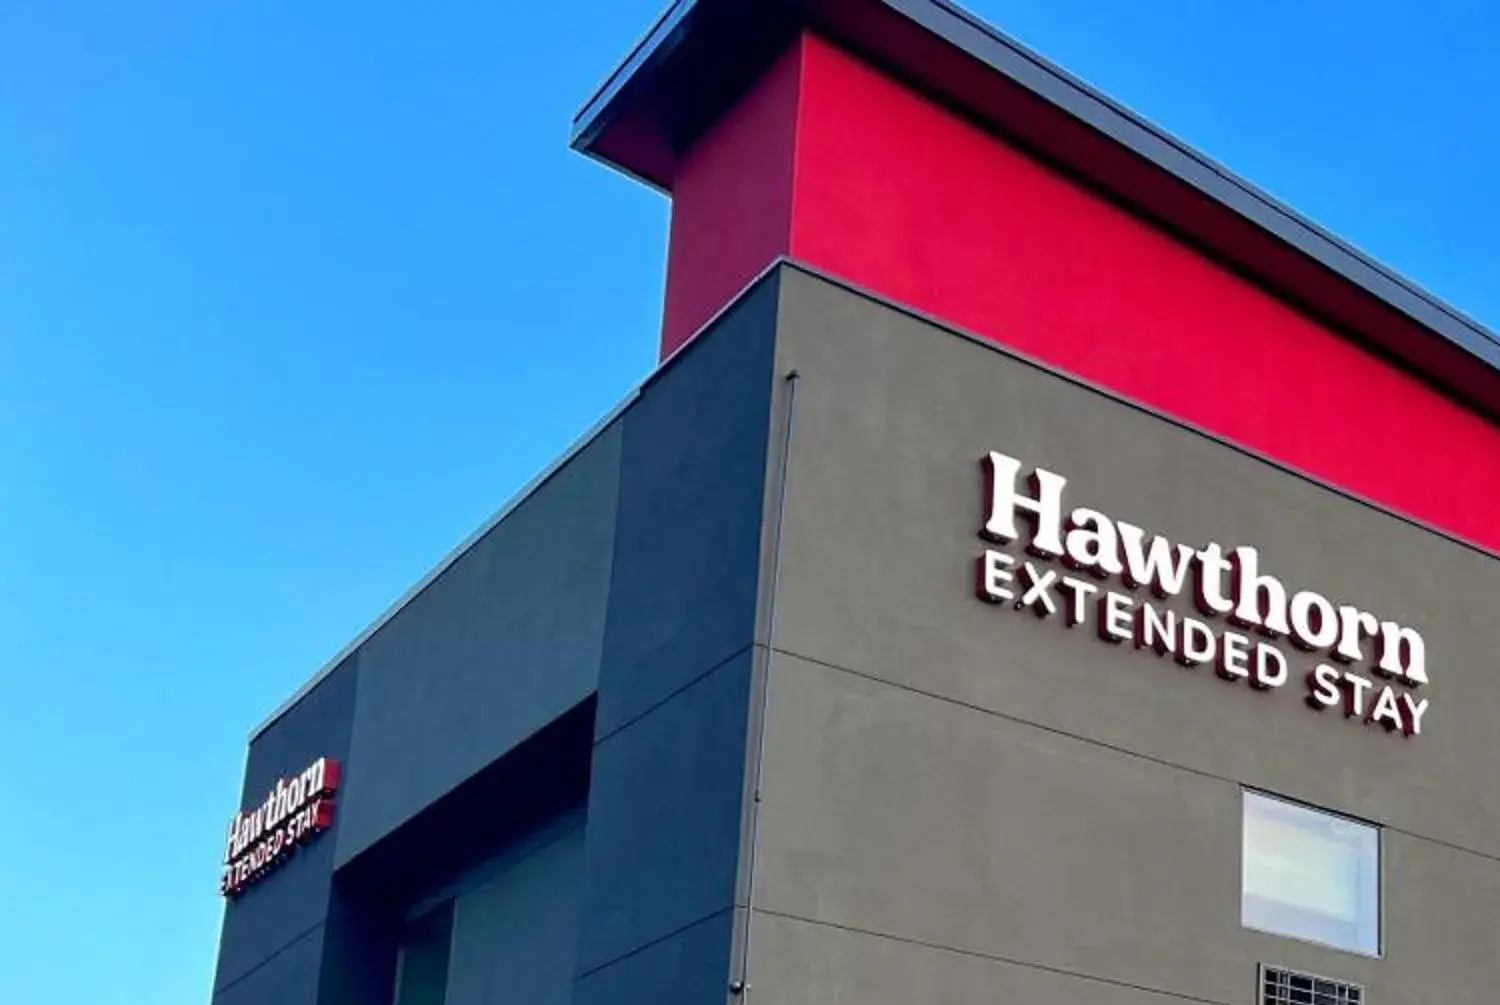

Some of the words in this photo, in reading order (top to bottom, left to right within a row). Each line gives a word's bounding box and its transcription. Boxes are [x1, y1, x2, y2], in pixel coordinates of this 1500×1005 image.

[983, 449, 1430, 685] Hawthorn
[983, 548, 1288, 688] EXTENDED
[1312, 663, 1430, 735] STAY
[224, 756, 326, 863] Hawthorn
[285, 798, 321, 845] STAY
